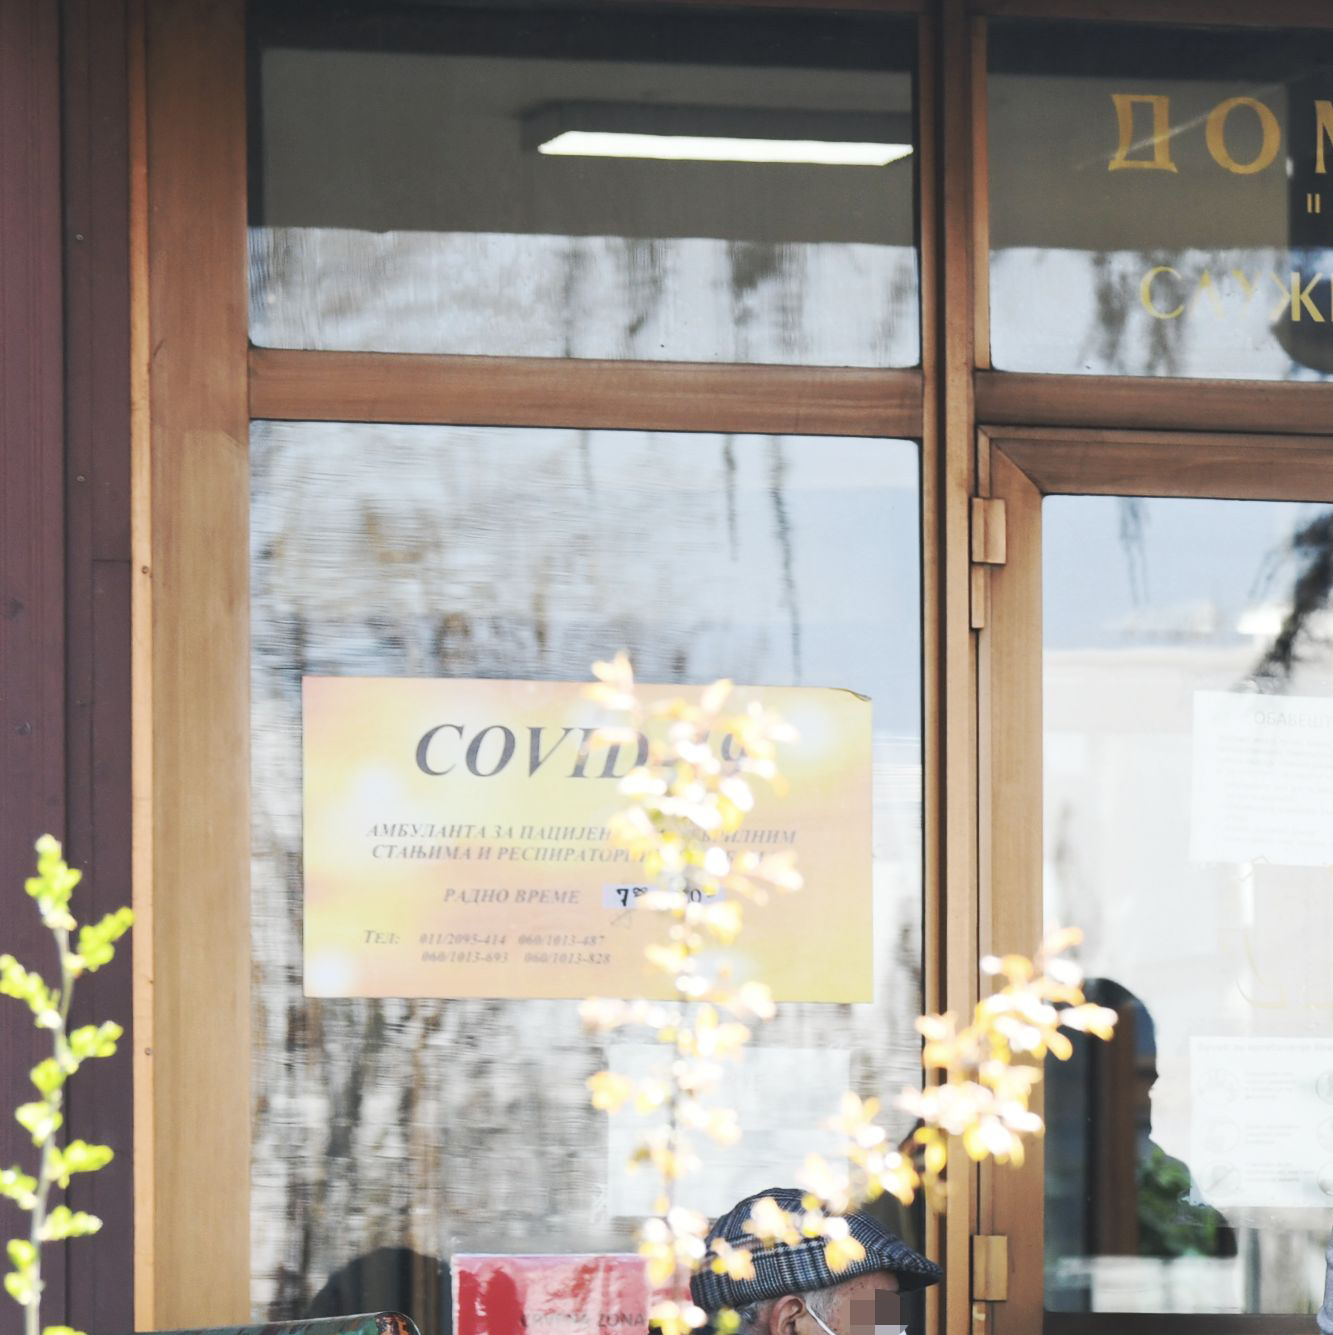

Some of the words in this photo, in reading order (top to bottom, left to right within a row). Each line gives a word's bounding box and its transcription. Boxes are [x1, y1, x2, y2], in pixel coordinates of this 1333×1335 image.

[415, 722, 750, 780] COVID-
[366, 823, 487, 839] АМБУЛАНТА
[493, 824, 514, 840] ЗА
[519, 824, 613, 842] ПАЦИЈЕН
[371, 844, 472, 860] СТАЊИМА
[478, 845, 492, 860] И
[497, 846, 648, 863] РЕСПИРАТОР
[443, 888, 510, 904] РАДНО
[515, 889, 582, 904] ВРЕМЕ
